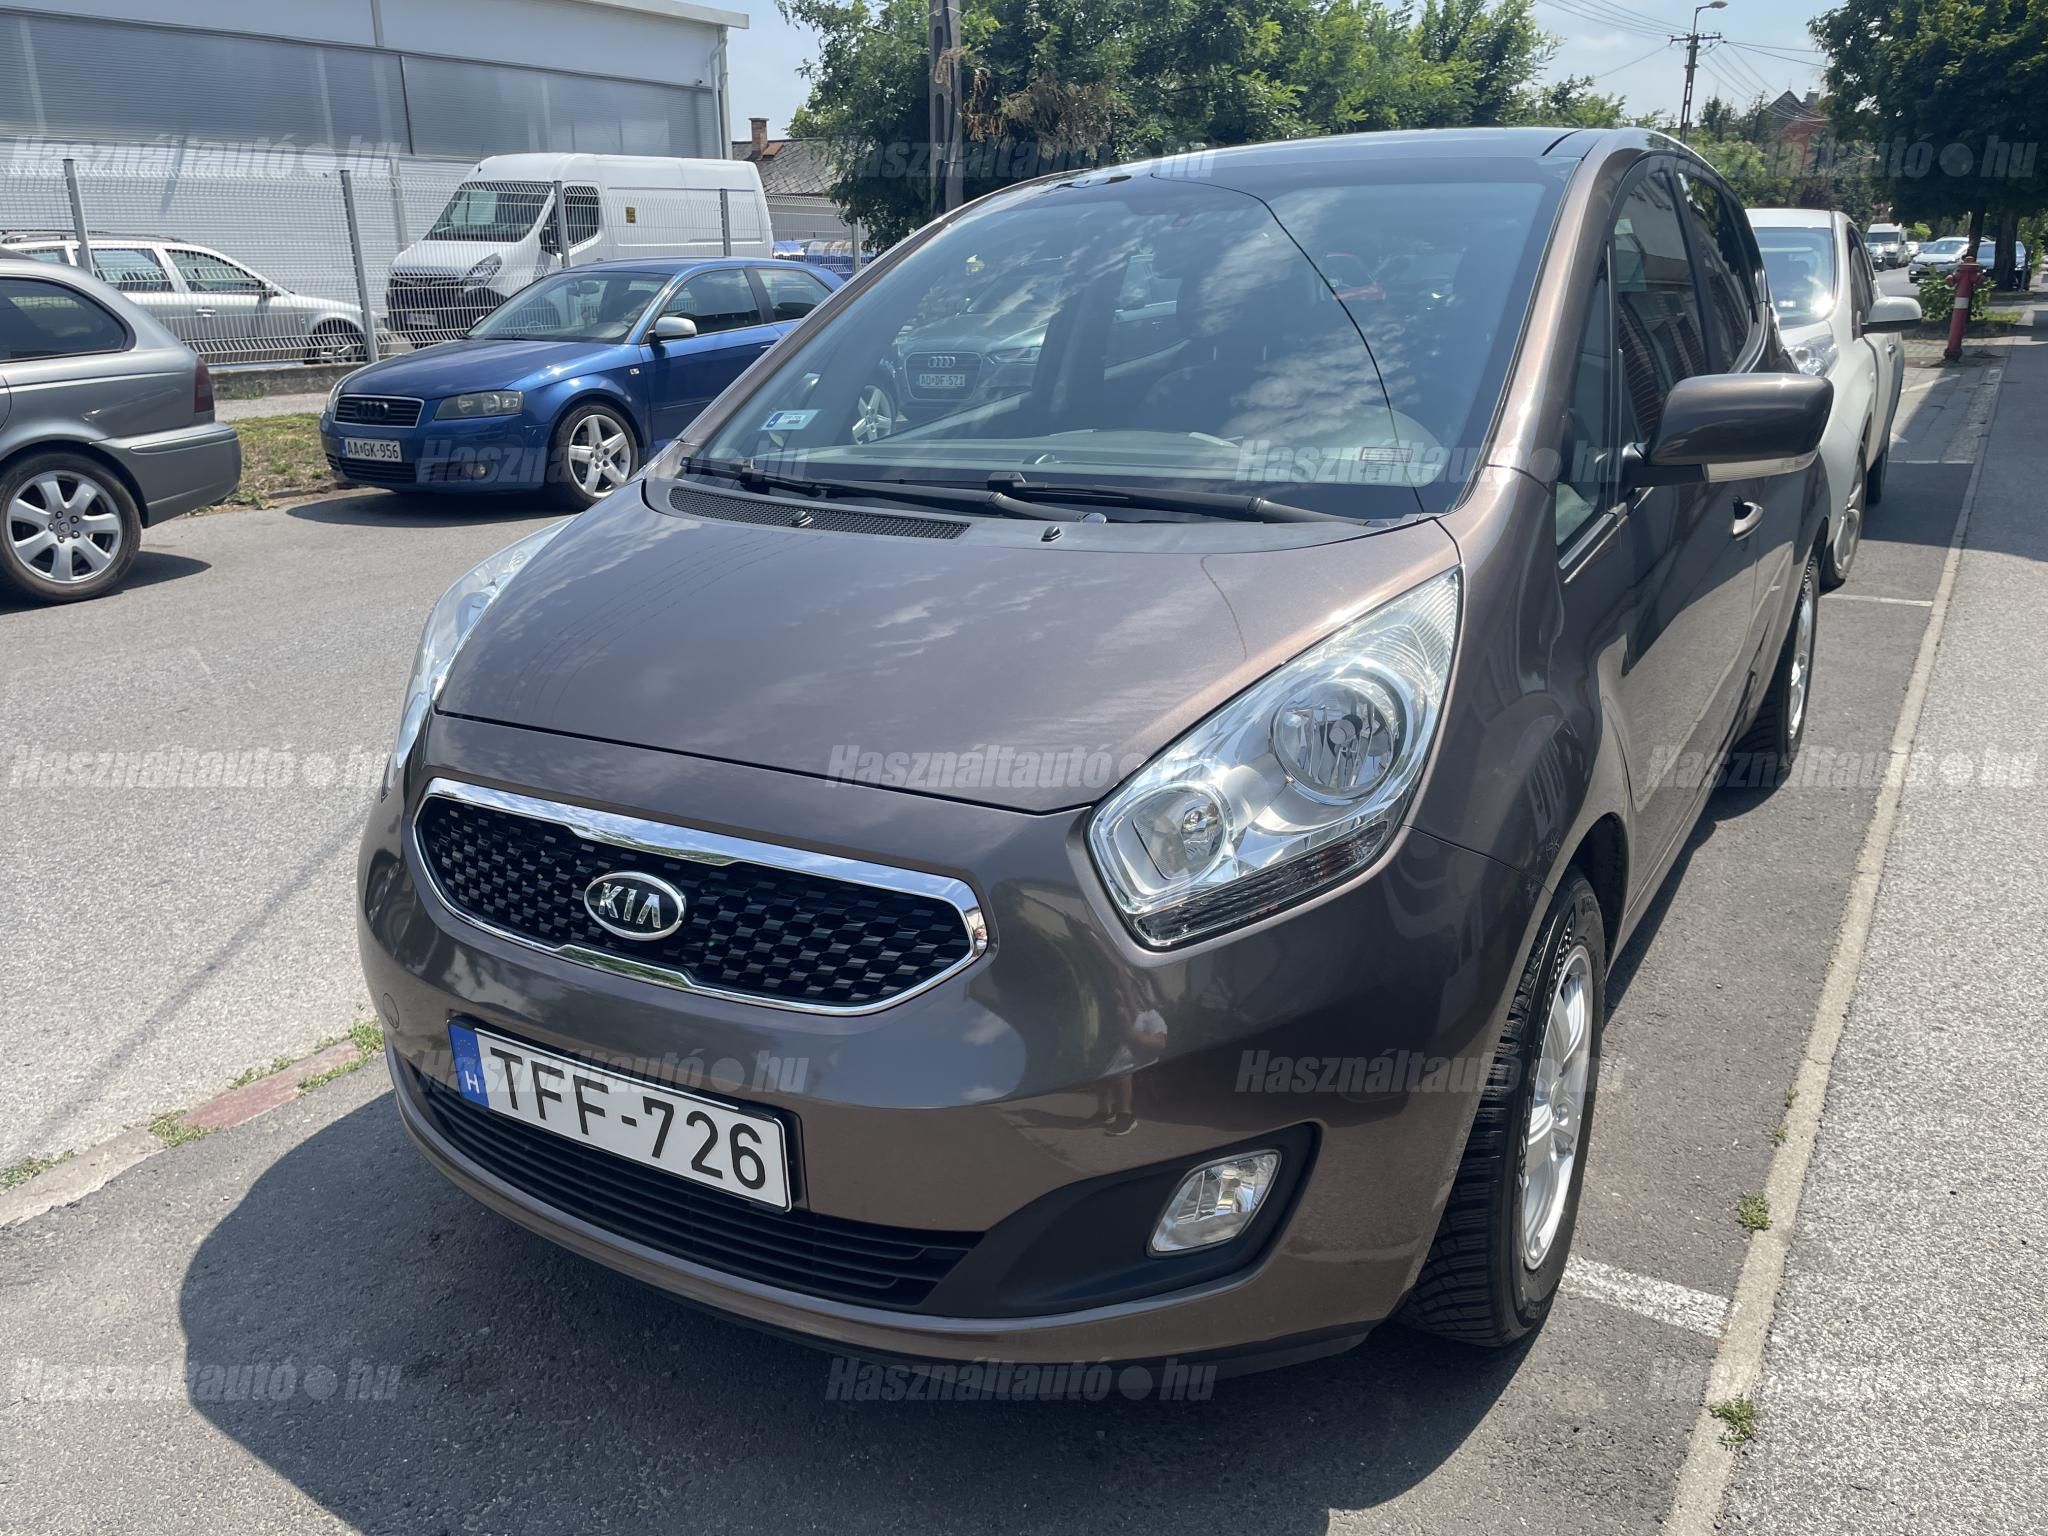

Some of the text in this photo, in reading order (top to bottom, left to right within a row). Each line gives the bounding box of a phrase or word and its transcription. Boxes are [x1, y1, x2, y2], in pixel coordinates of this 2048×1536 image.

[598, 882, 661, 928] KIA
[465, 1070, 479, 1094] H
[489, 1046, 766, 1190] TFF-726
